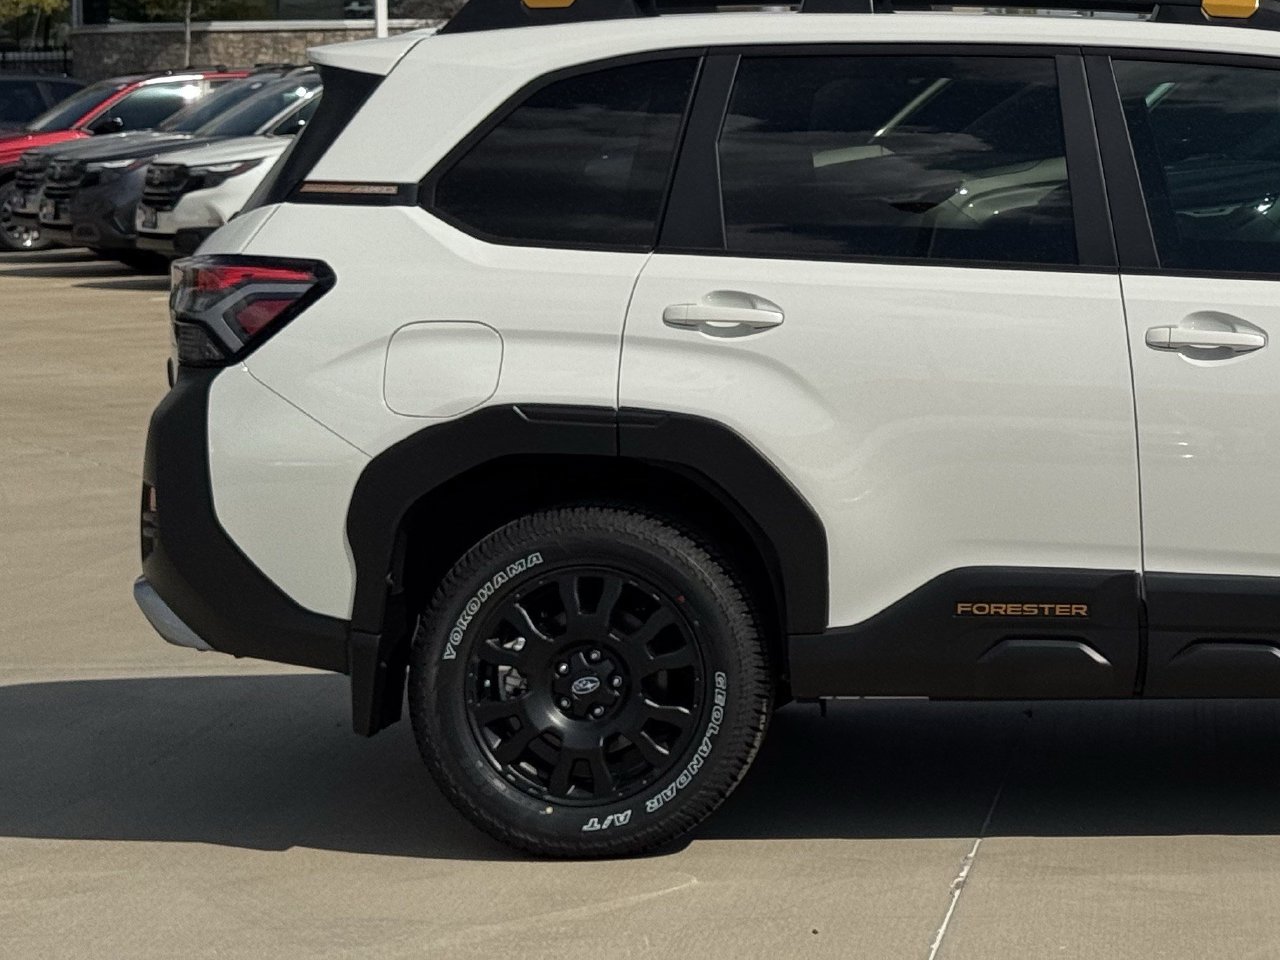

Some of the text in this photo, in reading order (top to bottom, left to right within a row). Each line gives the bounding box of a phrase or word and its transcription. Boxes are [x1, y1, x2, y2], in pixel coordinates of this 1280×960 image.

[443, 551, 544, 661] YOKOHAMA
[956, 603, 1088, 616] FORESTER
[581, 671, 727, 832] GEOLANDAR A/T
